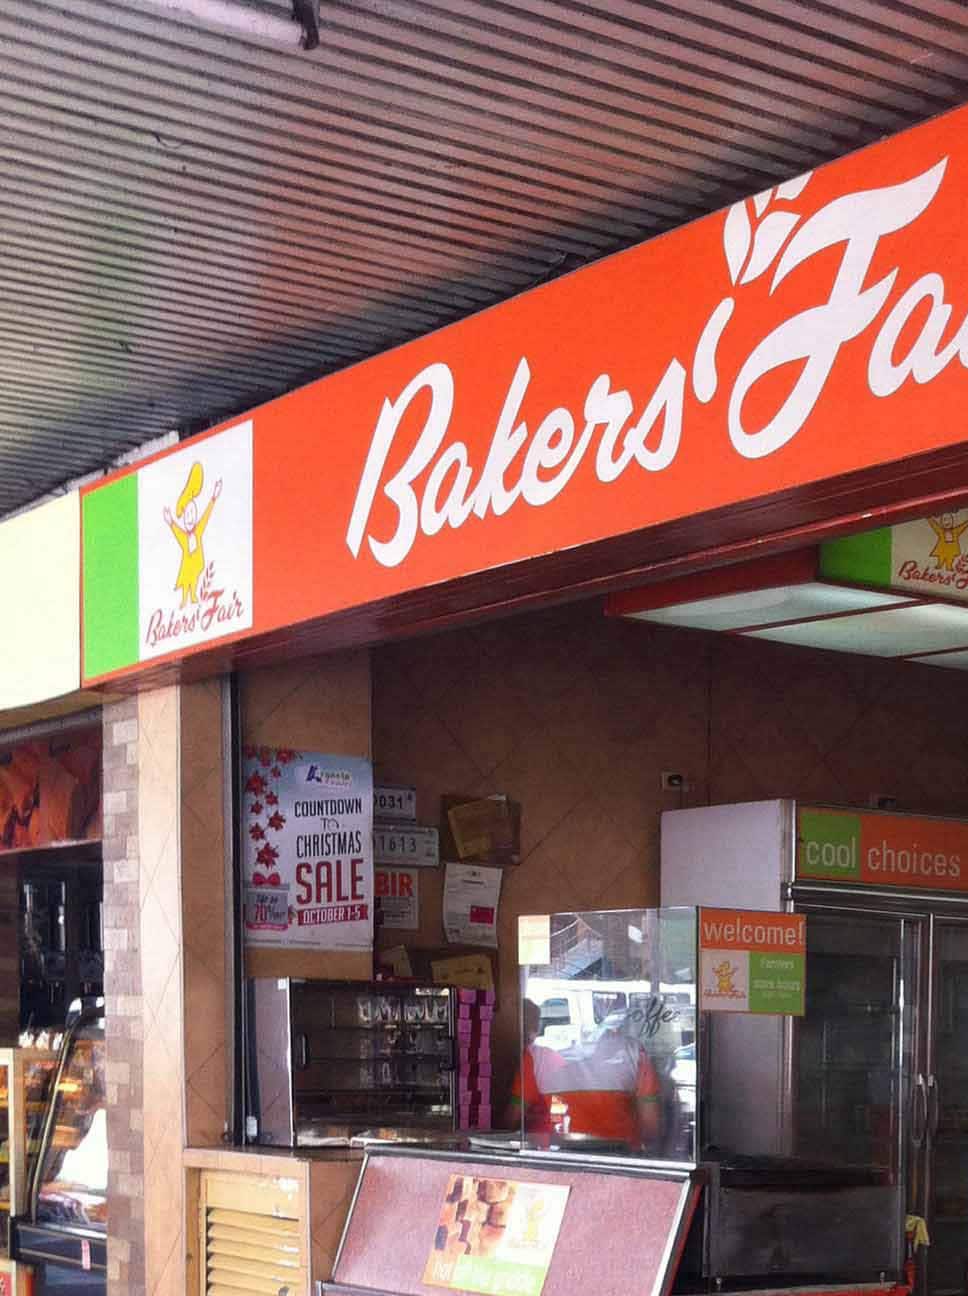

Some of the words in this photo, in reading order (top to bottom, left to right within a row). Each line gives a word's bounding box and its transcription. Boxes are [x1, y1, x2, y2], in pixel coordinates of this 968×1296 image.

[345, 297, 734, 567] Bakers'
[145, 604, 201, 646] Bakers'
[200, 588, 245, 631] Fair
[294, 797, 363, 817] COUNTDOWN
[319, 817, 340, 831] TO
[296, 830, 362, 858] CHRISTMAS
[805, 836, 857, 869] cool
[866, 839, 961, 878] choices
[296, 858, 365, 905] SALE
[303, 907, 344, 924] OCTOBER
